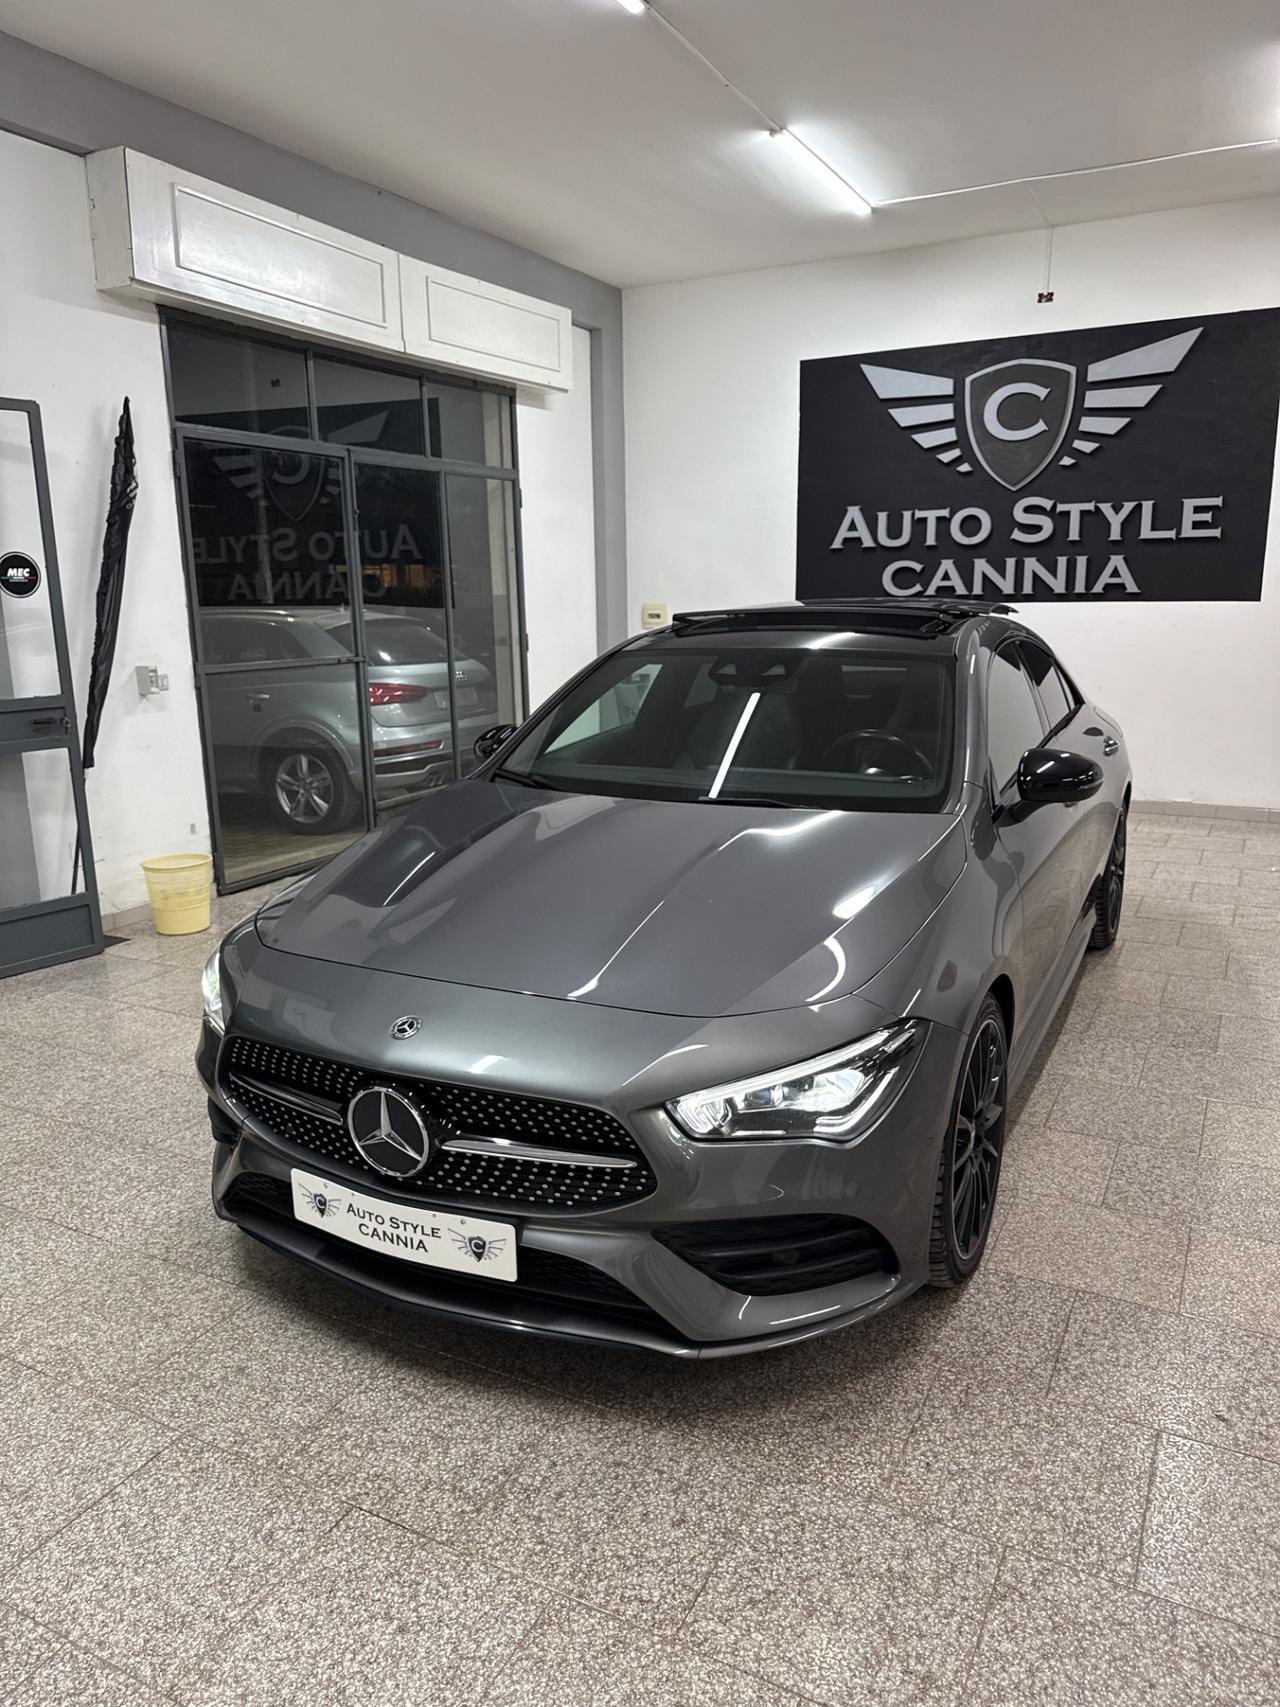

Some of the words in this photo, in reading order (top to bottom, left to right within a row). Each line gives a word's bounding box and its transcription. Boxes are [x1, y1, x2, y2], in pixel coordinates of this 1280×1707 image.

[983, 382, 1051, 441] C
[830, 505, 992, 549] AUTO
[1010, 496, 1223, 544] STYLE
[7, 567, 30, 577] MEC
[881, 554, 1141, 597] CANNIA
[346, 1203, 386, 1226] AUTO
[389, 1216, 442, 1239] STYLE
[358, 1223, 429, 1253] CANNIA
